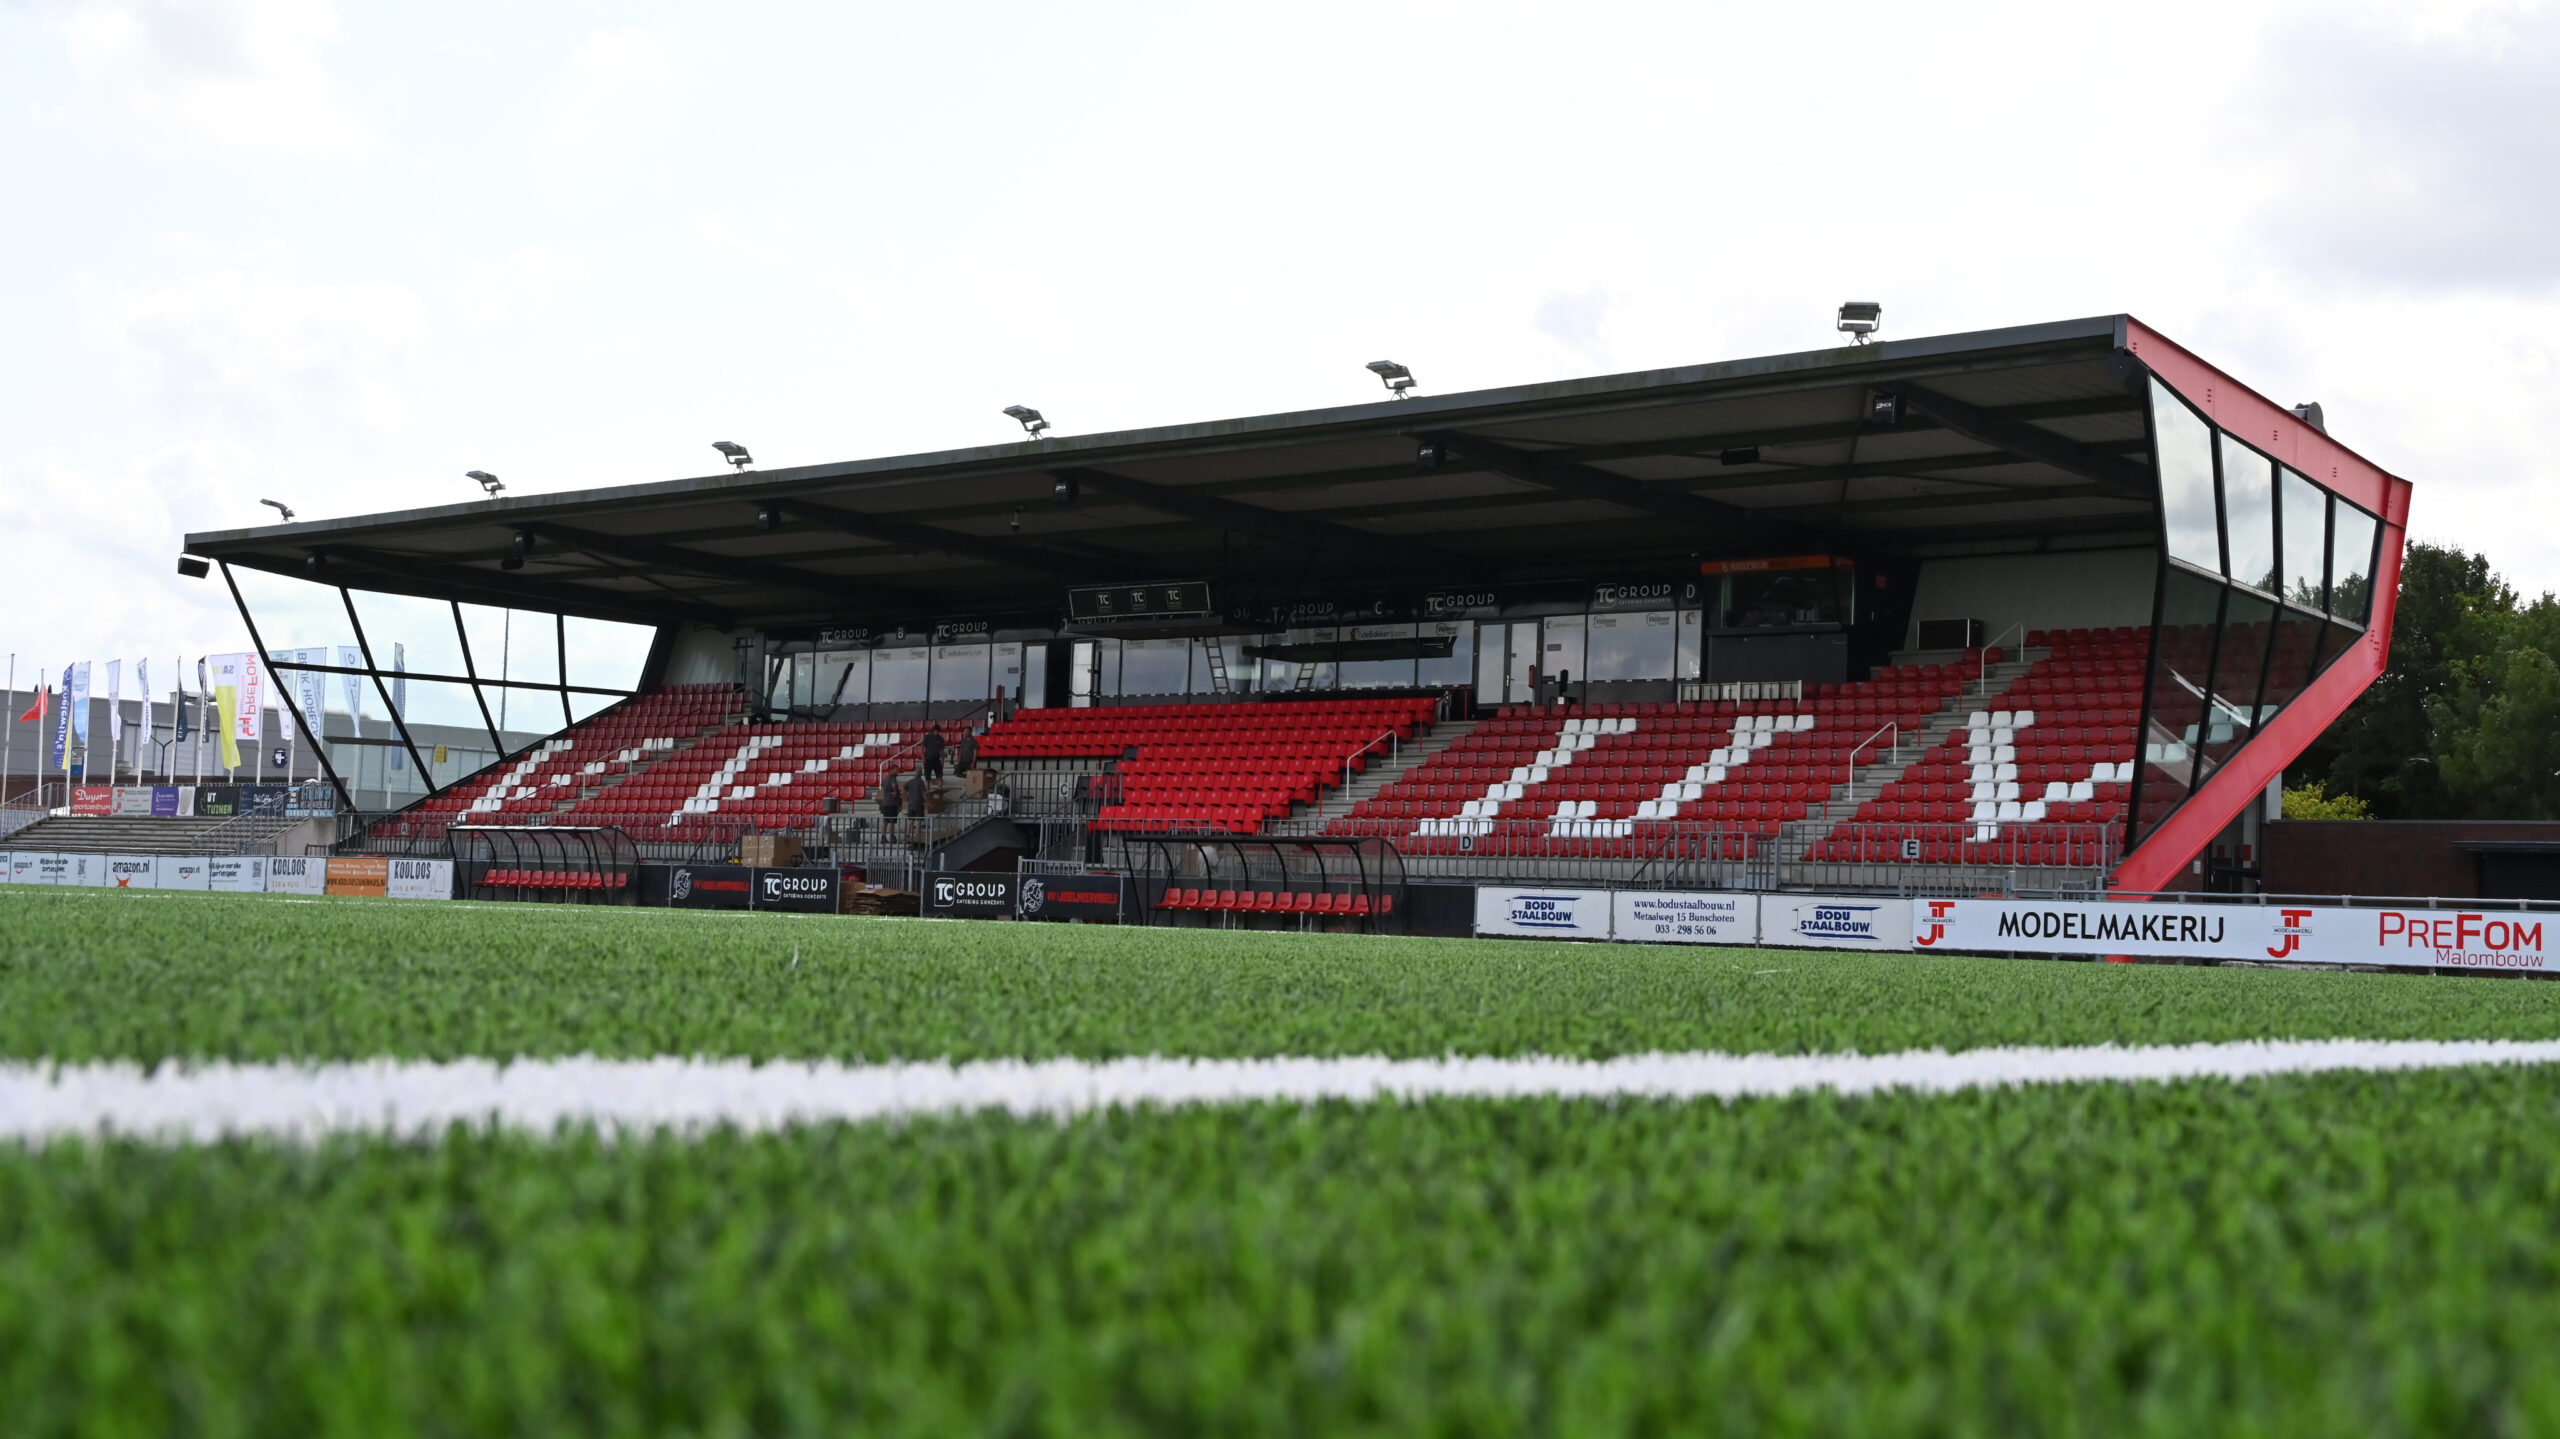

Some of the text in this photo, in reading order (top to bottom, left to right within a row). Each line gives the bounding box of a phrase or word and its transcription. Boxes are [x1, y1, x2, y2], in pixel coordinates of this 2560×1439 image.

[1132, 592, 1144, 602] TC
[1168, 590, 1180, 601] TC
[1597, 584, 1672, 603] TC GROUP
[1686, 584, 1695, 599] D
[1098, 594, 1109, 605] TC
[1427, 593, 1495, 612] TC GROUP
[937, 621, 988, 637] TC GROUP
[821, 628, 868, 644] TC GROUP
[1061, 783, 1068, 795] C
[207, 804, 233, 815] TUINEN
[402, 823, 407, 834] A
[1462, 836, 1471, 849] D
[1907, 841, 1917, 856] E
[113, 860, 150, 874] amazon.nl
[273, 858, 306, 876] KOOLOOS
[394, 861, 432, 880] KOOLOOS
[765, 877, 828, 895] TC GROUP
[936, 882, 1006, 901] TC GROUP
[1524, 901, 1556, 911] BODU
[1634, 899, 1736, 911] www.bodustaalbouw.nl
[1511, 910, 1572, 922] STAALBOUW
[1633, 911, 1736, 923] Metaalweg 15 Bunschoten
[1815, 910, 1851, 921] BODU
[1655, 924, 1670, 935] 033
[1676, 924, 1692, 935] 298
[1693, 925, 1705, 935] 56
[1706, 925, 1717, 936] 06
[1800, 920, 1871, 933] STAALBOUW
[1998, 911, 2224, 943] MODELMAKERIJ
[2273, 927, 2313, 935] MODELMAKERIJ
[2436, 948, 2544, 967] Malombouw
